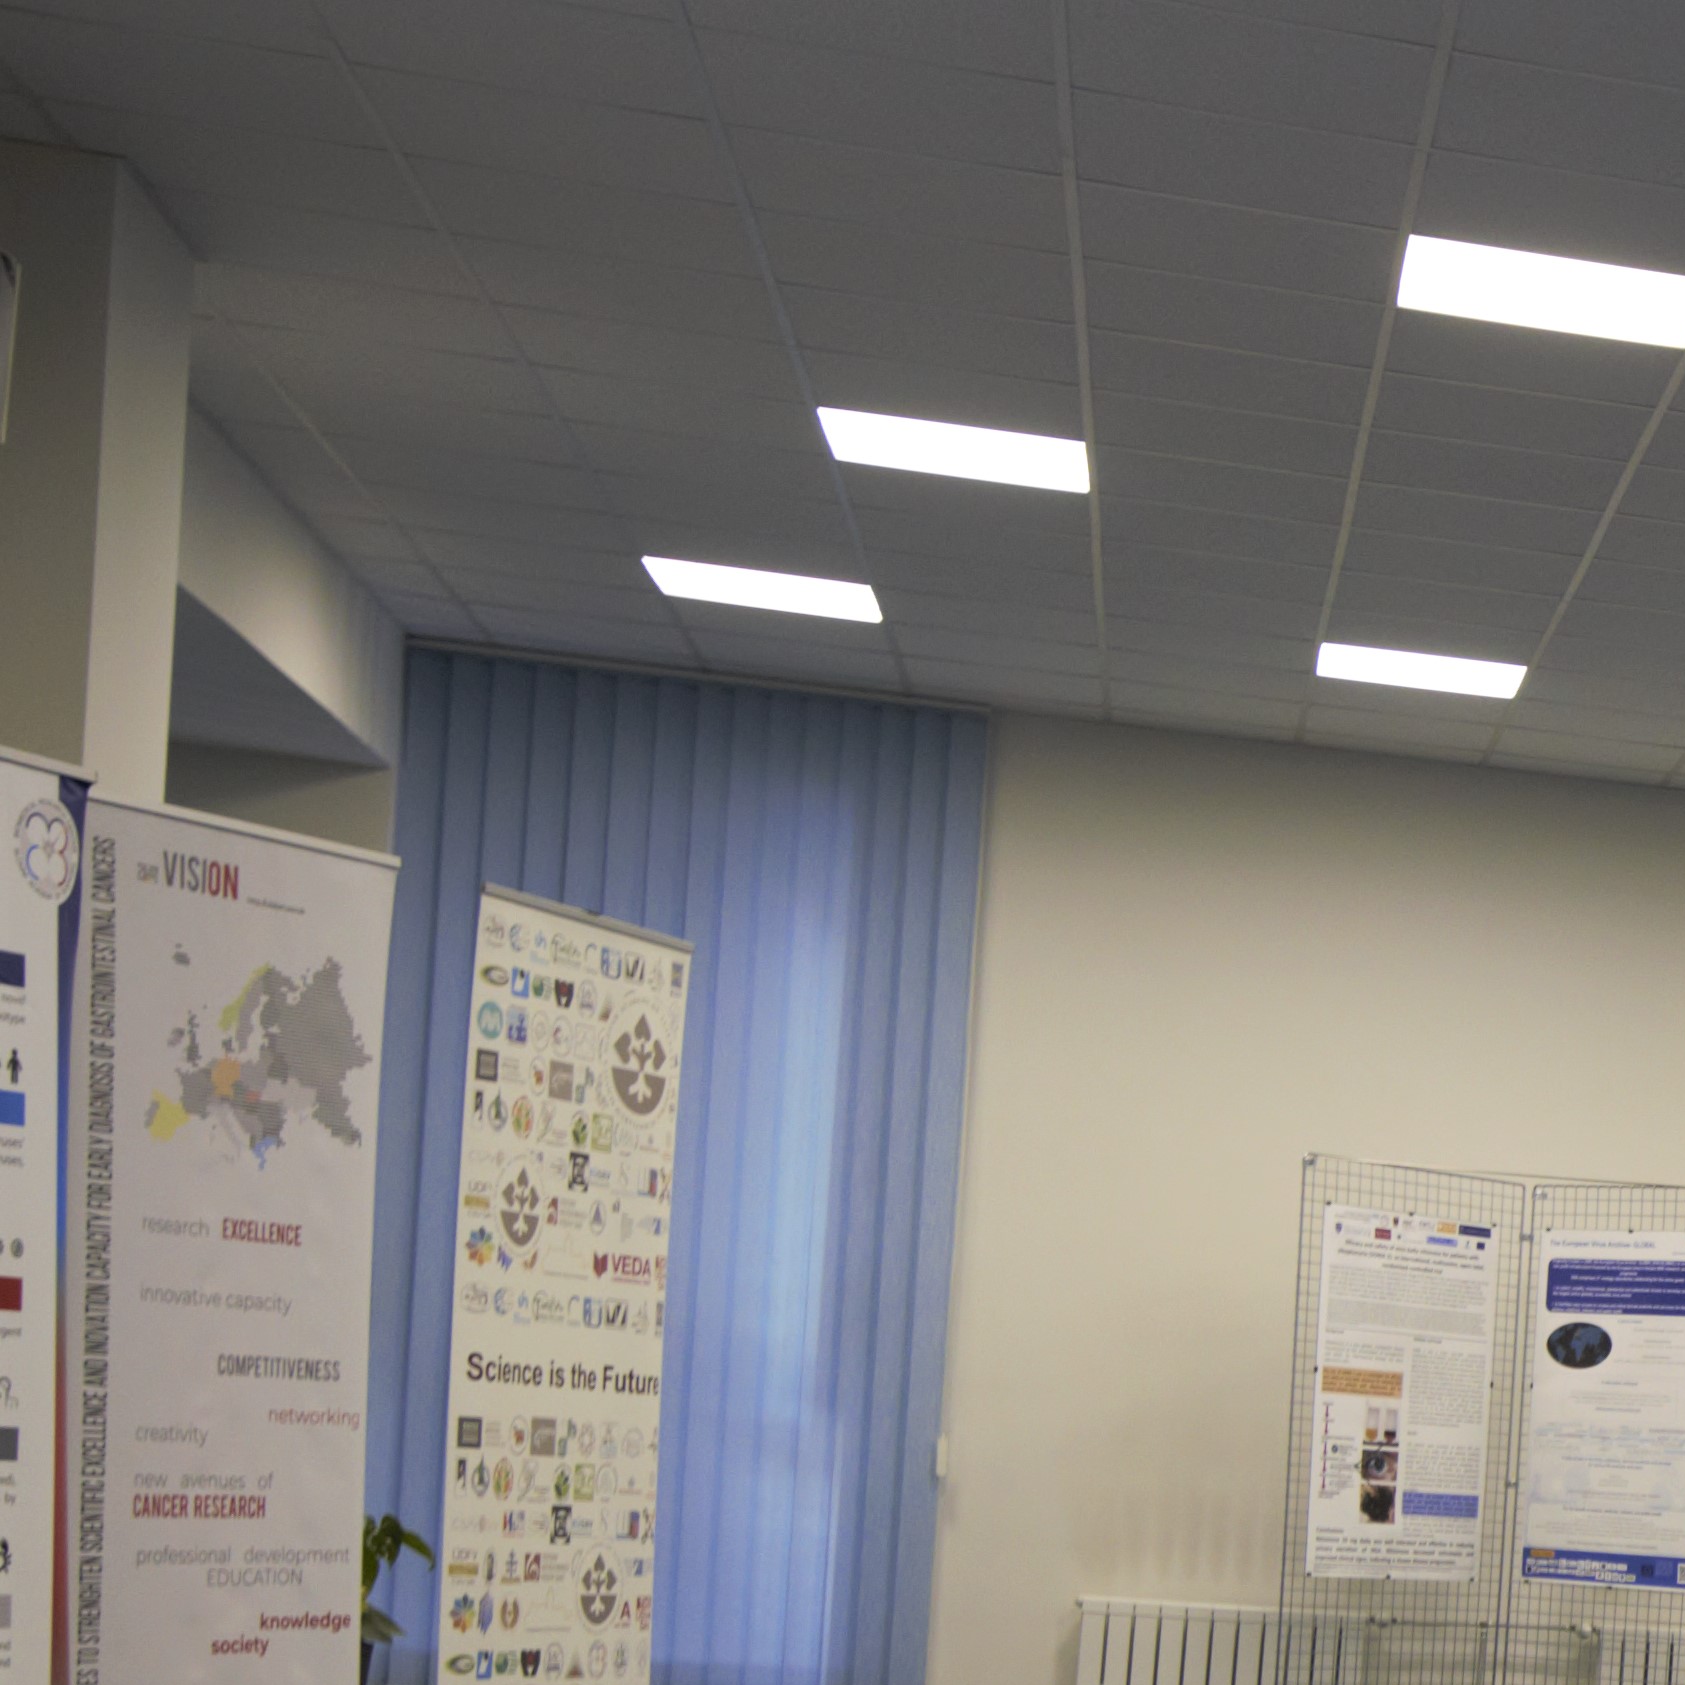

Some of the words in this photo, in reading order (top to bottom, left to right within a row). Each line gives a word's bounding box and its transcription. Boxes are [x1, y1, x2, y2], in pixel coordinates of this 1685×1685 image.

[92, 836, 116, 904] CANCERS
[163, 849, 239, 900] VISION
[90, 1042, 114, 1059] OF
[89, 1062, 114, 1133] DIAGNOSIS
[87, 1135, 113, 1181] EARLY
[86, 1183, 112, 1210] FOR
[142, 1216, 210, 1237] research
[222, 1217, 302, 1246] EXCELLENCE
[85, 1211, 111, 1281] CAPACITY
[612, 1253, 650, 1276] VEDA
[140, 1283, 222, 1308] innovative
[225, 1291, 292, 1317] capacity
[83, 1359, 108, 1388] AND
[217, 1353, 341, 1382] COMPETITIVENESS
[467, 1352, 542, 1386] Science
[550, 1359, 565, 1388] is
[571, 1362, 596, 1391] the
[602, 1365, 659, 1396] Future
[268, 1407, 361, 1431] networking
[81, 1391, 107, 1477] EXCELLENCE
[135, 1422, 208, 1447] creativity
[134, 1472, 168, 1489] new
[181, 1474, 247, 1490] avenues
[257, 1471, 274, 1490] of
[80, 1479, 105, 1553] SCIENTIFIC
[133, 1494, 188, 1519] CANCER
[194, 1494, 266, 1519] RESEARCH
[136, 1544, 231, 1568] professional
[243, 1546, 350, 1566] development
[206, 1567, 303, 1588] EDUCATION
[259, 1611, 351, 1633] knowledge
[77, 1648, 99, 1666] TO
[211, 1635, 269, 1658] society
